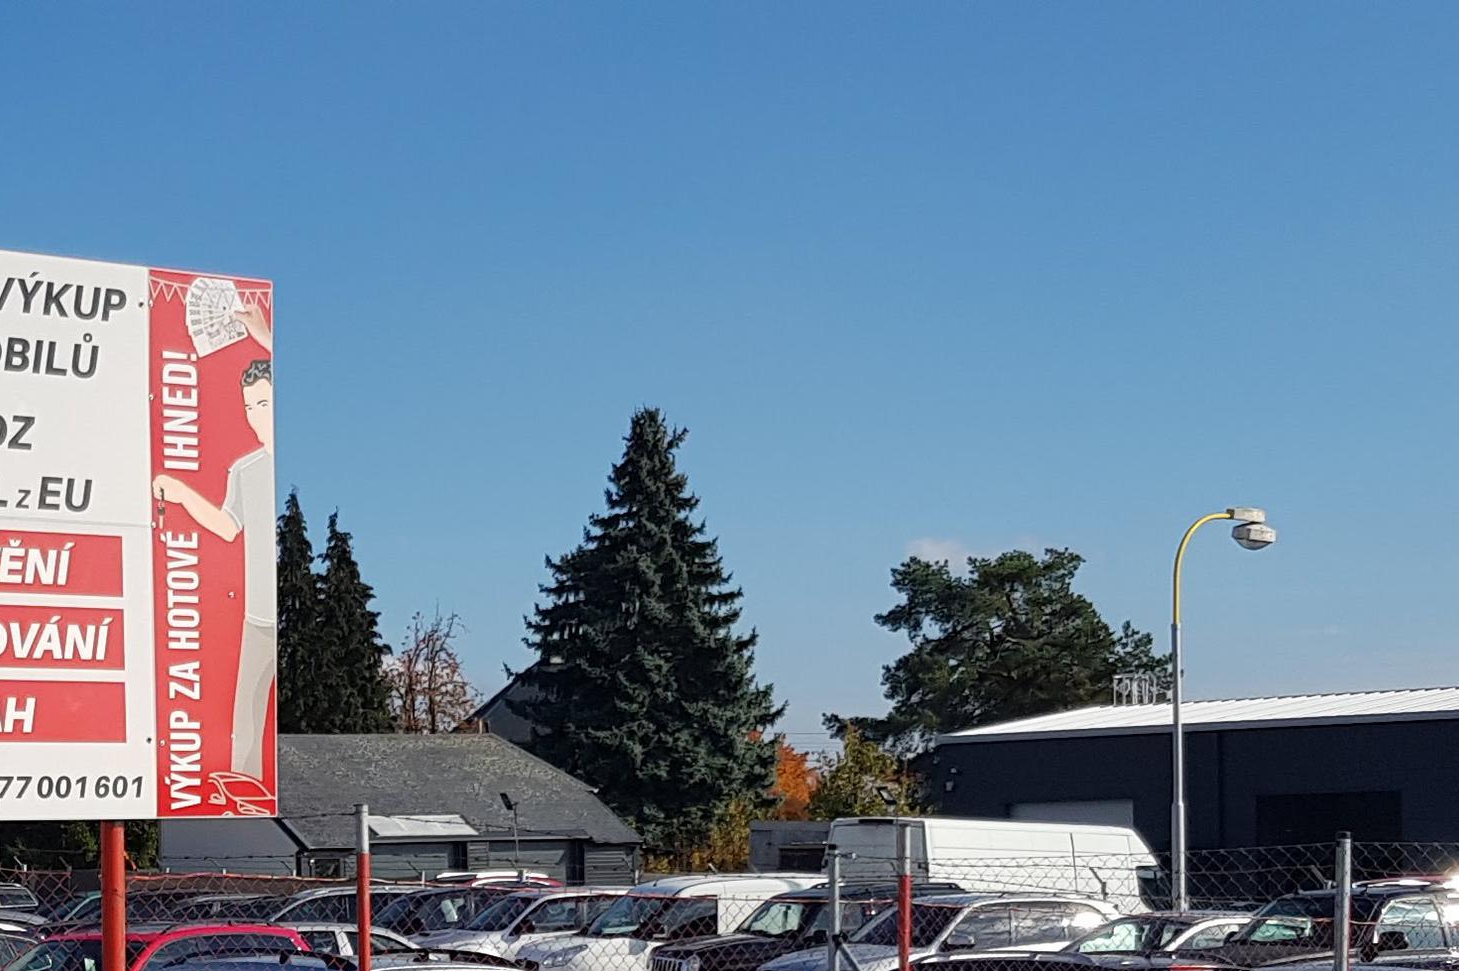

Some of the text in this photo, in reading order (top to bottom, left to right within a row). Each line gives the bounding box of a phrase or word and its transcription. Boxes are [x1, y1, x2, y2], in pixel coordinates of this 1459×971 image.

[38, 476, 93, 512] EU
[160, 350, 202, 810] VÝKUP ZA HOTOVÉ IHNED!
[37, 776, 88, 799] 001
[94, 776, 144, 799] 601
